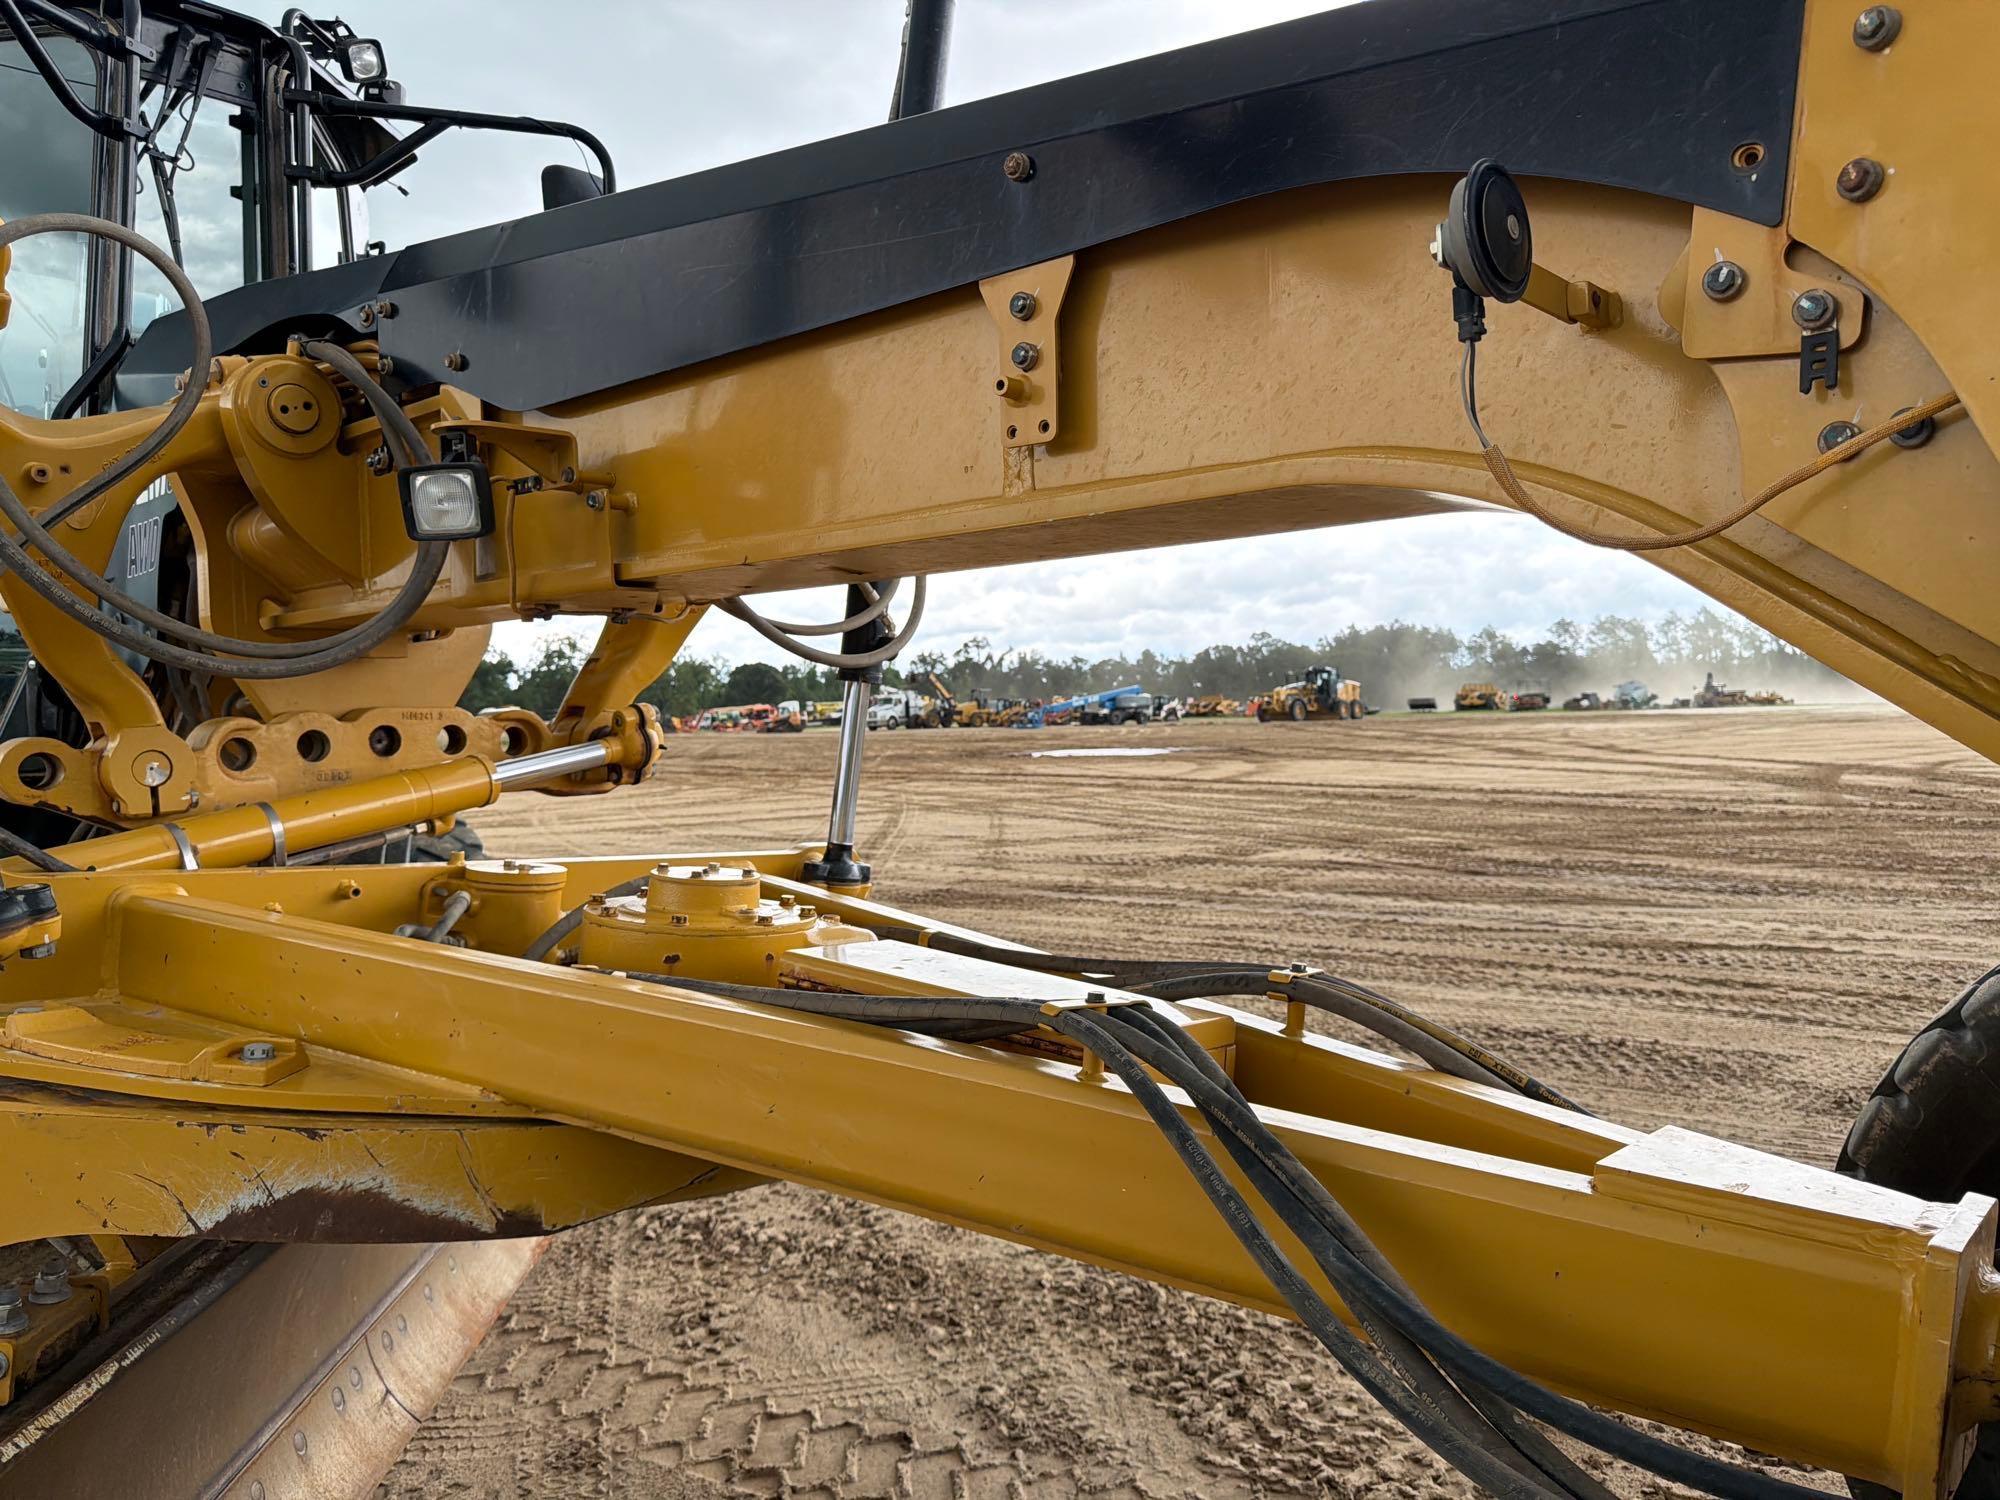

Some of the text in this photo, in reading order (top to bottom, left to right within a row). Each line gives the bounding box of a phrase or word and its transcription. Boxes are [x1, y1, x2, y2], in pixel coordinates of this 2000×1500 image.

[127, 516, 160, 578] AWD
[1468, 1047, 1481, 1059] CAT
[1494, 1062, 1525, 1084] XT-3ES
[1210, 1174, 1229, 1197] MSHA
